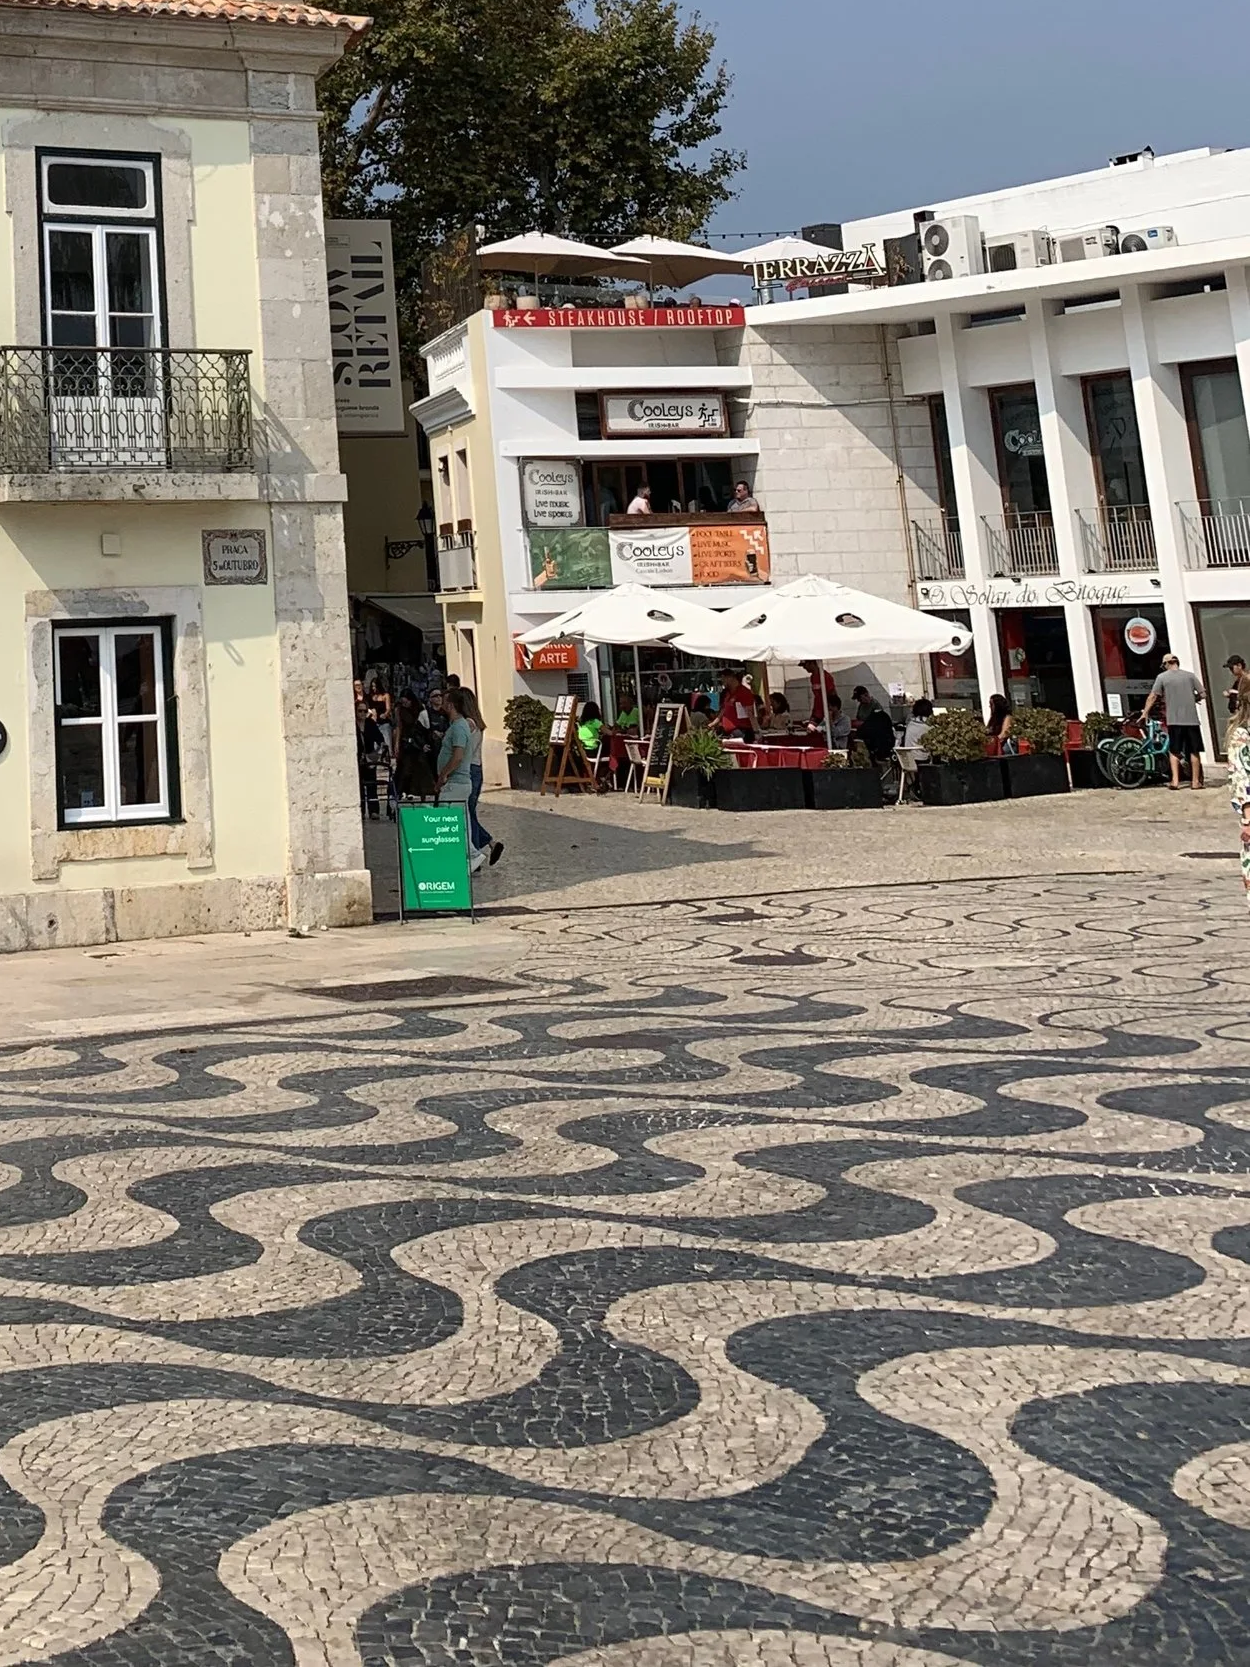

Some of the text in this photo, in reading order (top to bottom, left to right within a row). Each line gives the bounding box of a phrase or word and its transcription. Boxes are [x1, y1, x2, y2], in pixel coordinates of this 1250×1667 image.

[743, 243, 887, 290] TERRAZZA
[350, 241, 391, 388] RETAIL
[548, 309, 645, 326] STEAKHOUSE
[667, 309, 733, 326] ROOFTOP
[627, 398, 694, 424] Cooleys
[529, 469, 574, 486] Cooleys
[616, 541, 685, 563] Cooleys
[213, 560, 218, 571] 5
[223, 559, 259, 571] OUTUBRO
[950, 584, 1009, 606] Solar
[1015, 584, 1037, 604] do
[1045, 580, 1128, 607] Bitoque
[539, 653, 569, 664] ARTE
[423, 815, 440, 823] Your
[435, 824, 459, 834] pair of
[421, 836, 460, 845] sunglasses
[418, 881, 455, 891] ORIGEM
